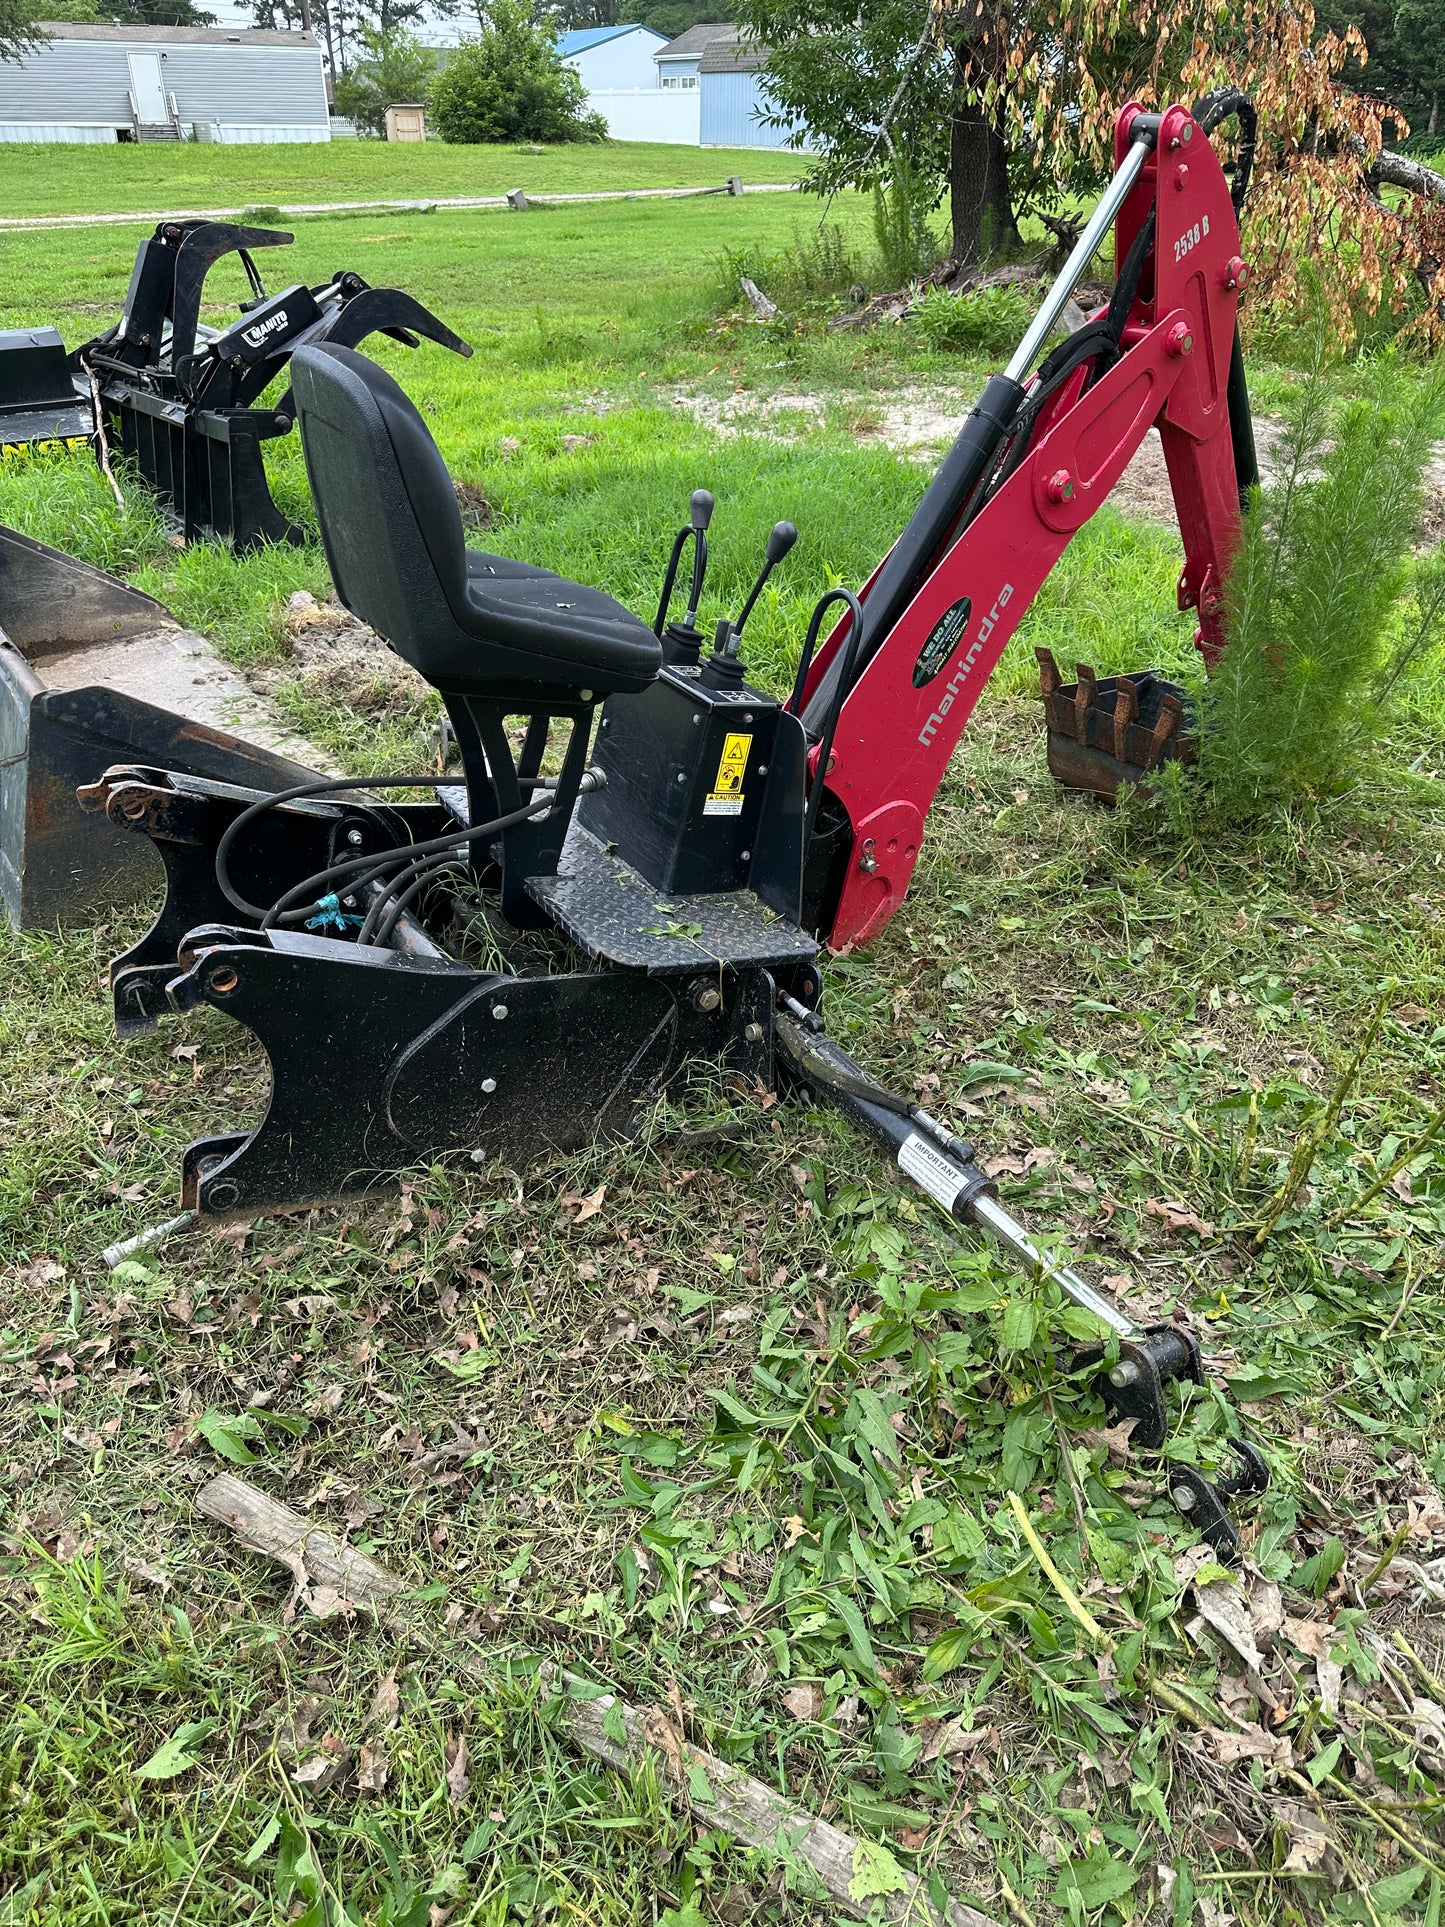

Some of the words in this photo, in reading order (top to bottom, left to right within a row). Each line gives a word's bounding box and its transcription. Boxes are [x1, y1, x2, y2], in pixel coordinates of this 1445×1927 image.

[1174, 223, 1200, 263] 2538
[1202, 214, 1210, 237] B
[922, 641, 936, 658] WE
[932, 625, 946, 642] DO
[941, 607, 957, 627] ALL
[914, 1141, 958, 1180] IMPORTANT
